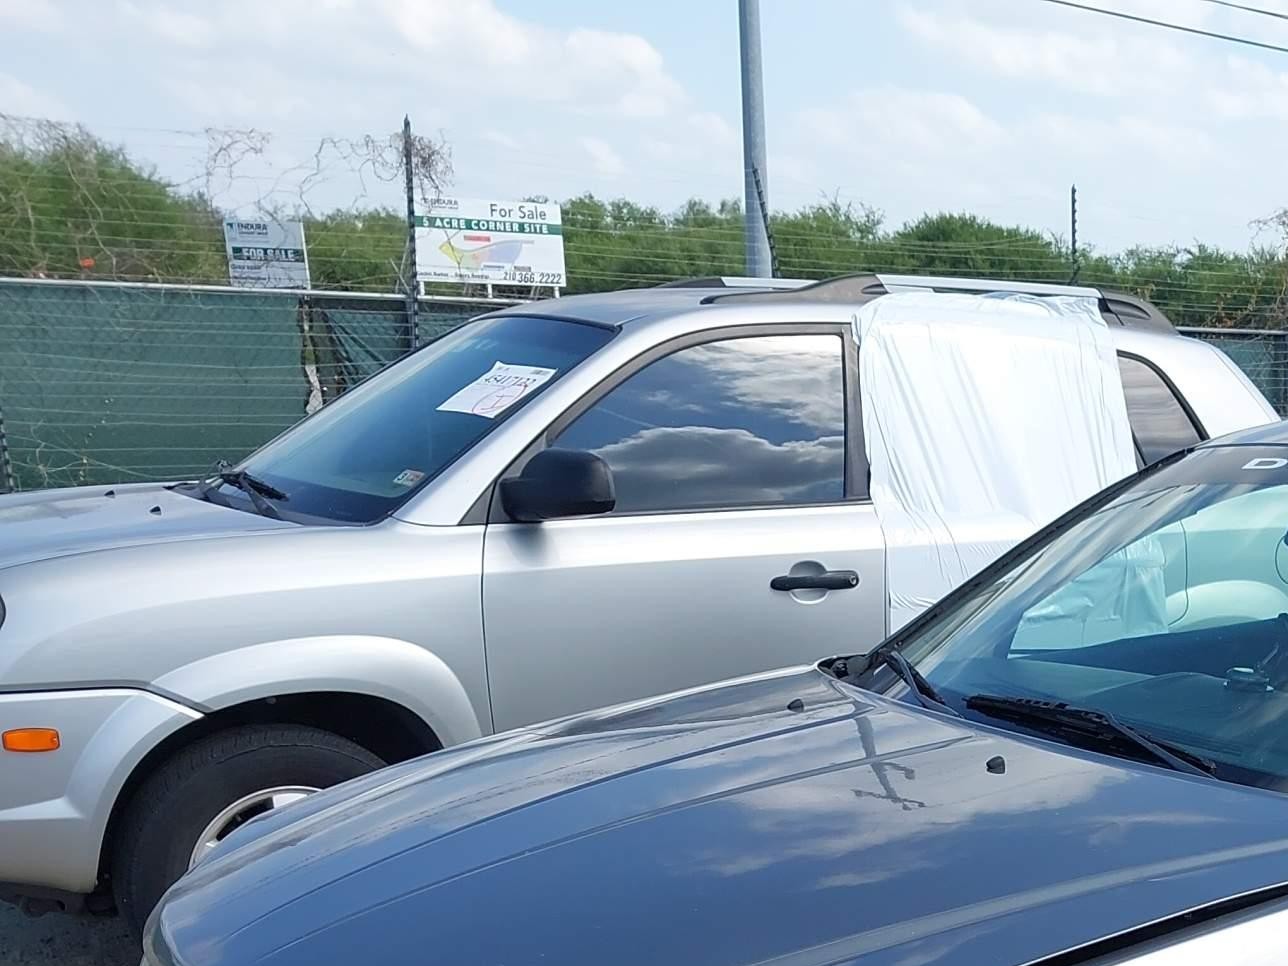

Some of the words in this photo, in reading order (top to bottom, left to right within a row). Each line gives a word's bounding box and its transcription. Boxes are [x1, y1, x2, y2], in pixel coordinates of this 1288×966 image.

[490, 203, 514, 218] For
[518, 205, 547, 220] Sale
[423, 216, 429, 226] 5
[435, 217, 466, 229] ACRE
[472, 219, 520, 232] CORNER
[524, 222, 549, 234] SITE
[242, 248, 264, 260] FOR
[267, 249, 295, 261] SALE
